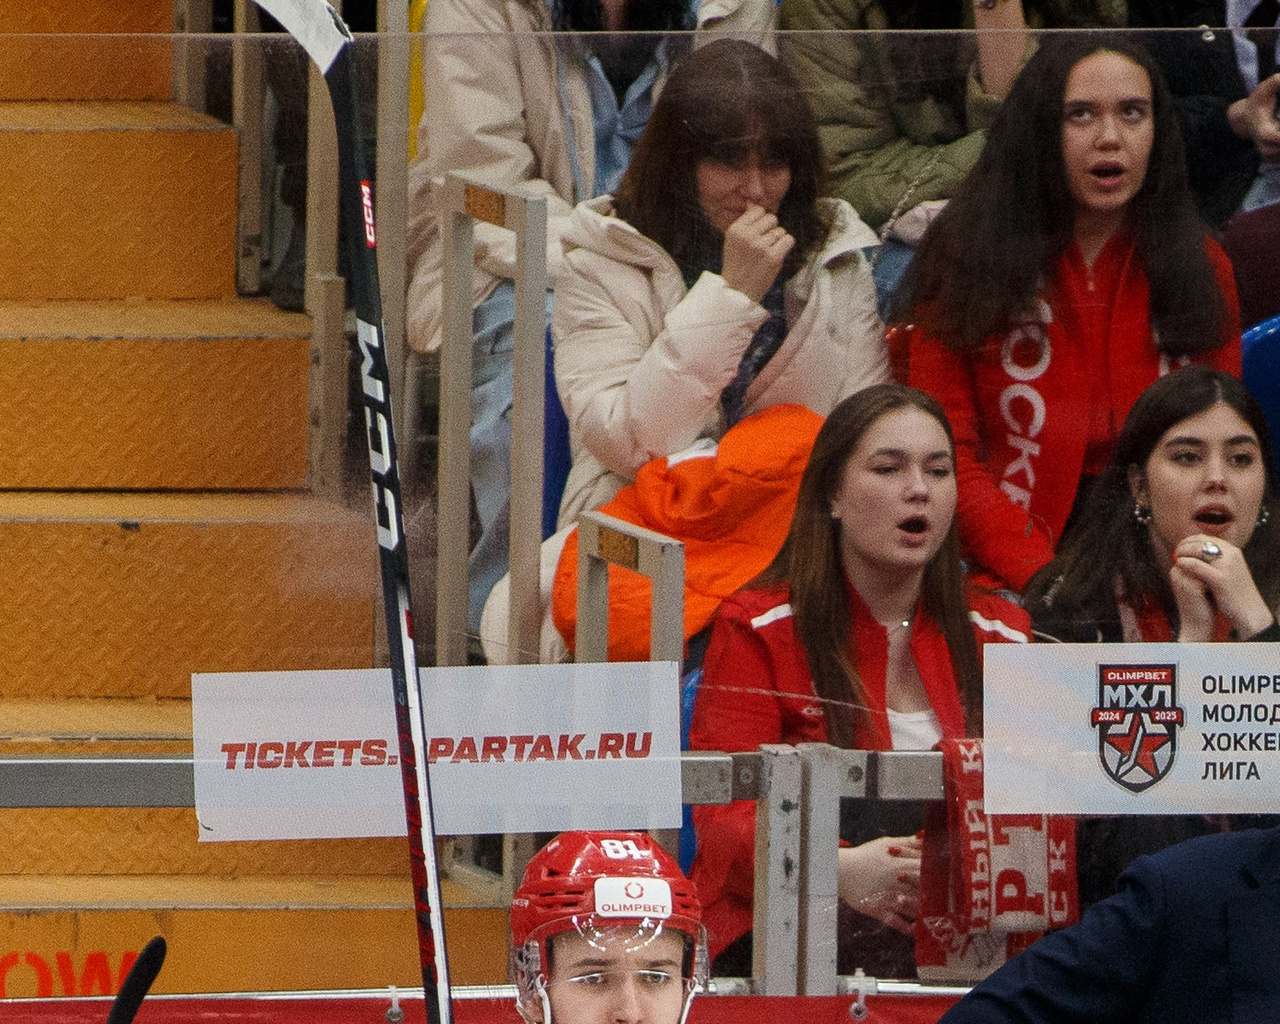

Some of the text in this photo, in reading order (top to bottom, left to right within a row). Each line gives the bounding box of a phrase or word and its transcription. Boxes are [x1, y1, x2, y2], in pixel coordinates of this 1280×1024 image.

[361, 184, 378, 245] CCM
[356, 318, 398, 551] CCM
[1107, 671, 1168, 681] OLIMPBET
[1103, 684, 1172, 708] МХЛ
[1098, 711, 1120, 722] 2024
[1154, 711, 1177, 721] 2025
[221, 731, 653, 771] TICKETS.PARTAK.RU
[1201, 761, 1261, 781] ЛИГА
[601, 838, 649, 861] 81
[601, 903, 667, 914] OLIMPBET
